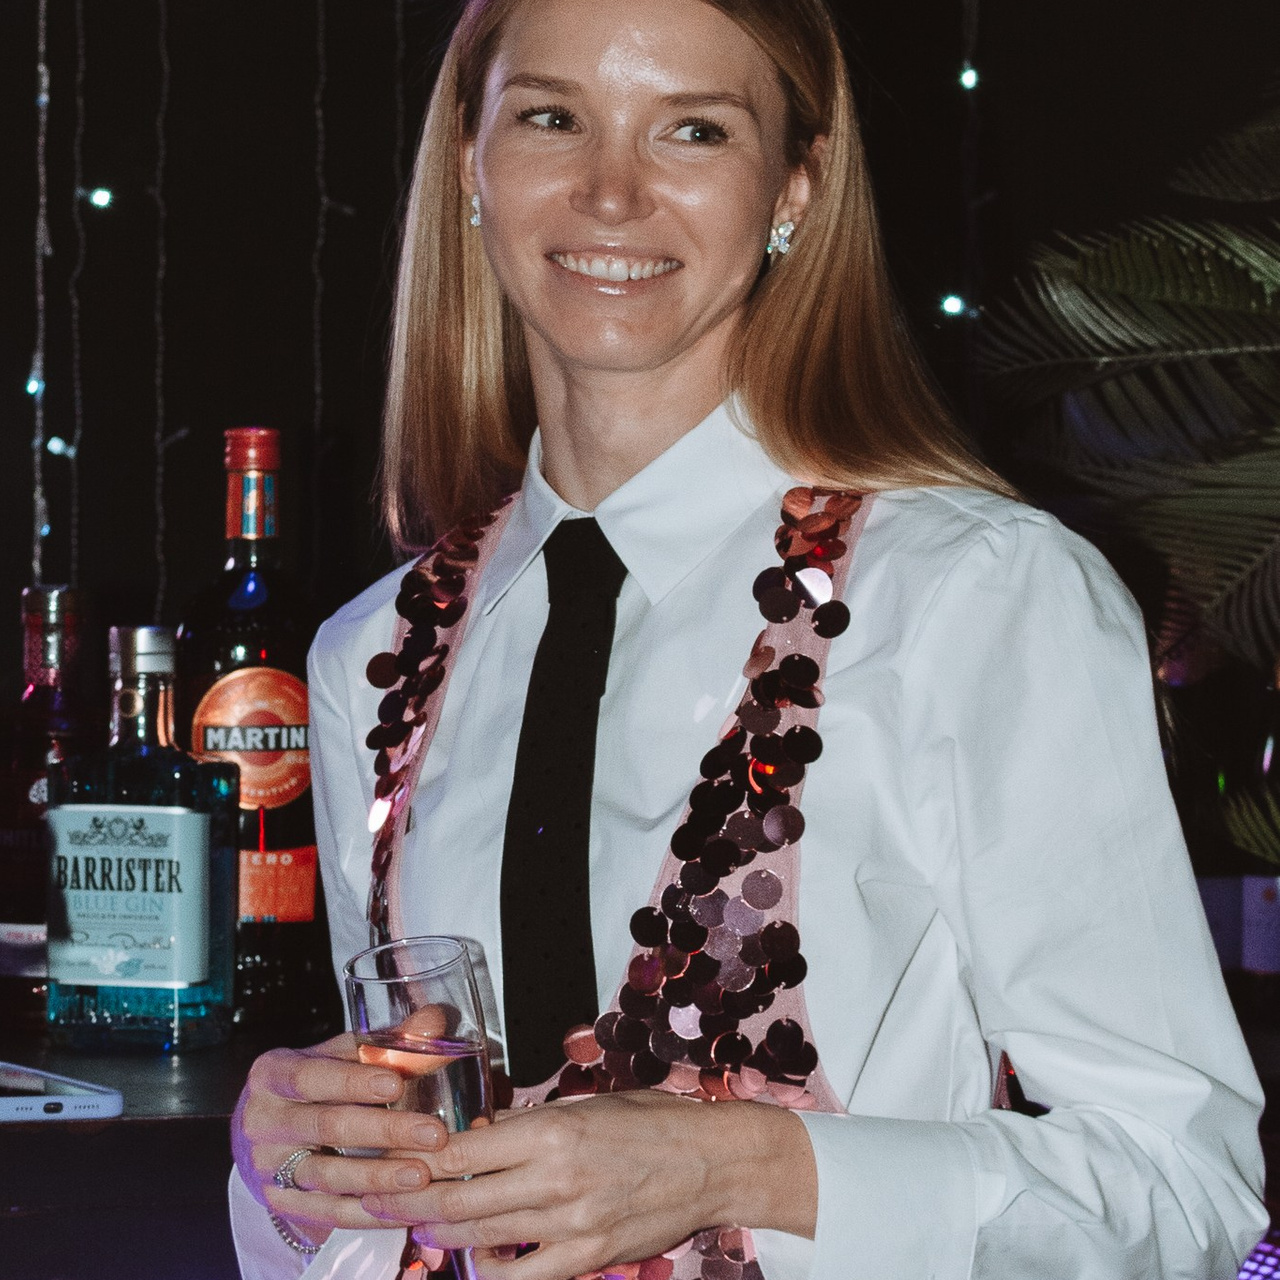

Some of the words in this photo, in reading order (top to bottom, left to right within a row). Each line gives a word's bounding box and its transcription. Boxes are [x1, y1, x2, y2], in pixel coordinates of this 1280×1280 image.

[206, 726, 309, 750] MARTIN
[56, 855, 183, 893] BARRISTER
[72, 894, 119, 912] BLUE
[124, 895, 165, 913] GIN
